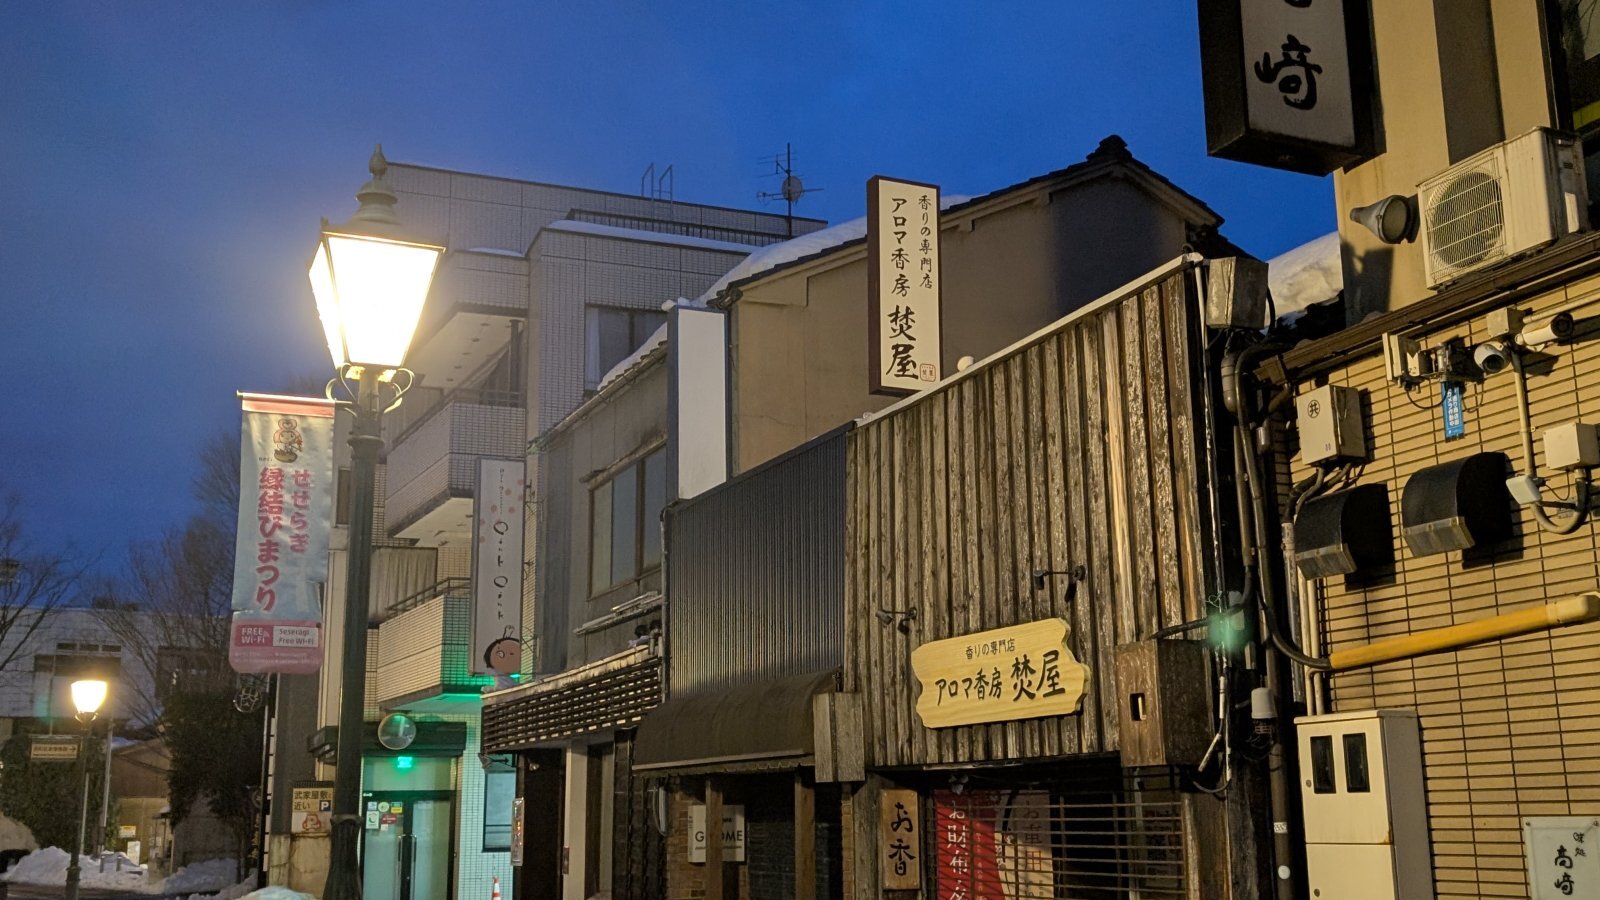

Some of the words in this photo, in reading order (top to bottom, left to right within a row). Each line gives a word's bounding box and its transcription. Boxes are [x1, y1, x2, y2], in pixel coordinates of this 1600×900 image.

[1254, 0, 1323, 111] 崎
[891, 197, 911, 297] アロマ香房
[918, 194, 933, 289] 香りの専門店
[886, 304, 919, 381] 焚屋
[256, 465, 285, 612] 縁結びまつり
[290, 468, 311, 553] せせらぎ
[242, 627, 264, 636] FREE
[279, 628, 310, 637] Seseragi
[965, 637, 1016, 660] 香りの専門店
[935, 666, 1002, 706] アロマ香房
[1010, 649, 1066, 702] 焚屋
[888, 802, 916, 876] お香
